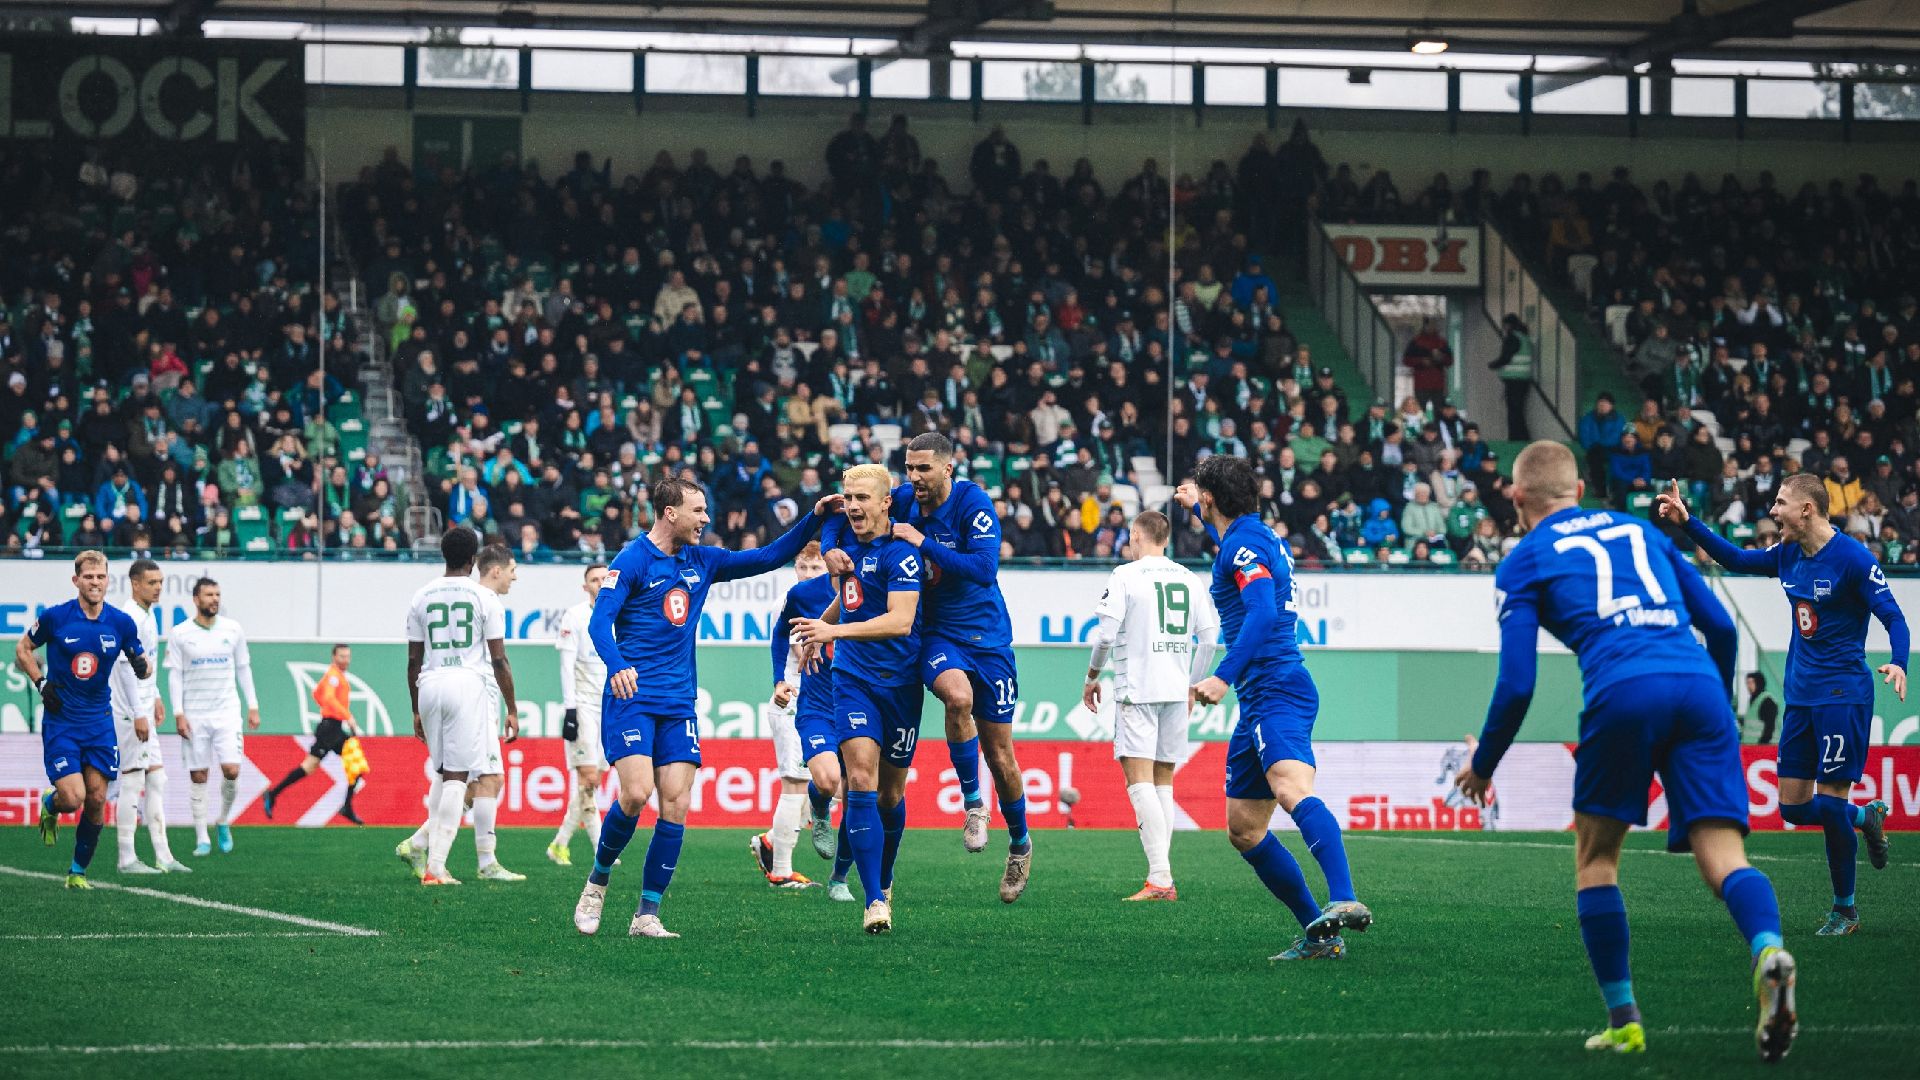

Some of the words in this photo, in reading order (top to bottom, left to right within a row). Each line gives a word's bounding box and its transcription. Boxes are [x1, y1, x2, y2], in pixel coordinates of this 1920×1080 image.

[0, 53, 290, 142] LOCK
[1334, 234, 1468, 273] OBI
[1553, 523, 1657, 620] 27
[669, 595, 686, 619] B
[845, 581, 859, 605] B
[1154, 581, 1190, 634] 19
[426, 601, 474, 650] 23
[1798, 607, 1812, 631] B
[76, 656, 92, 674] B
[995, 677, 1016, 706] 18
[892, 727, 916, 752] 20
[1822, 734, 1846, 763] 22
[1348, 794, 1484, 831] Simba
